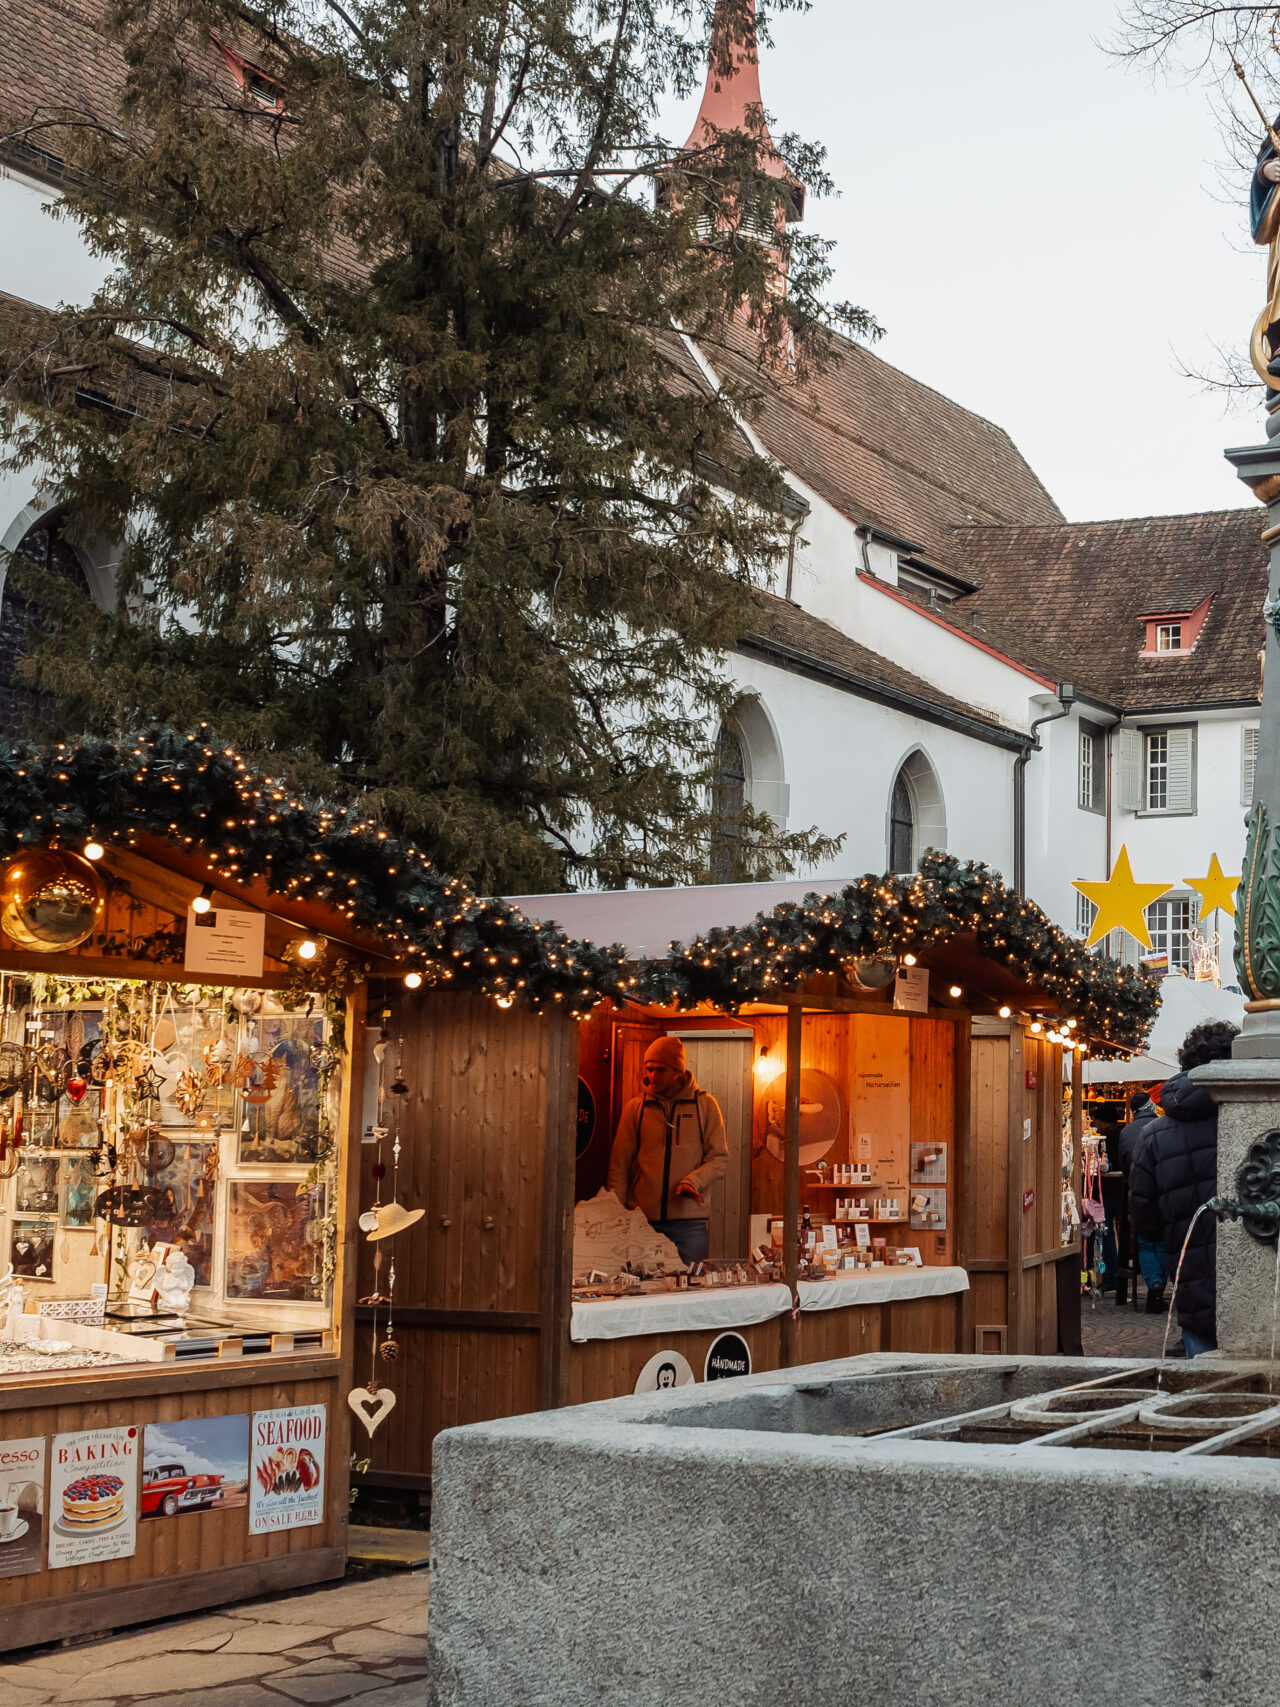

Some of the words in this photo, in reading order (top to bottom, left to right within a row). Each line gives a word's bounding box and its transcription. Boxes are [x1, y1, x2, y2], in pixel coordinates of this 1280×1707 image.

[257, 1416, 322, 1446] SEAFOOD
[0, 1449, 39, 1464] esso
[58, 1441, 132, 1464] BAKING
[63, 1460, 126, 1473] Competition
[255, 1516, 268, 1528] ON
[270, 1512, 292, 1526] SALE
